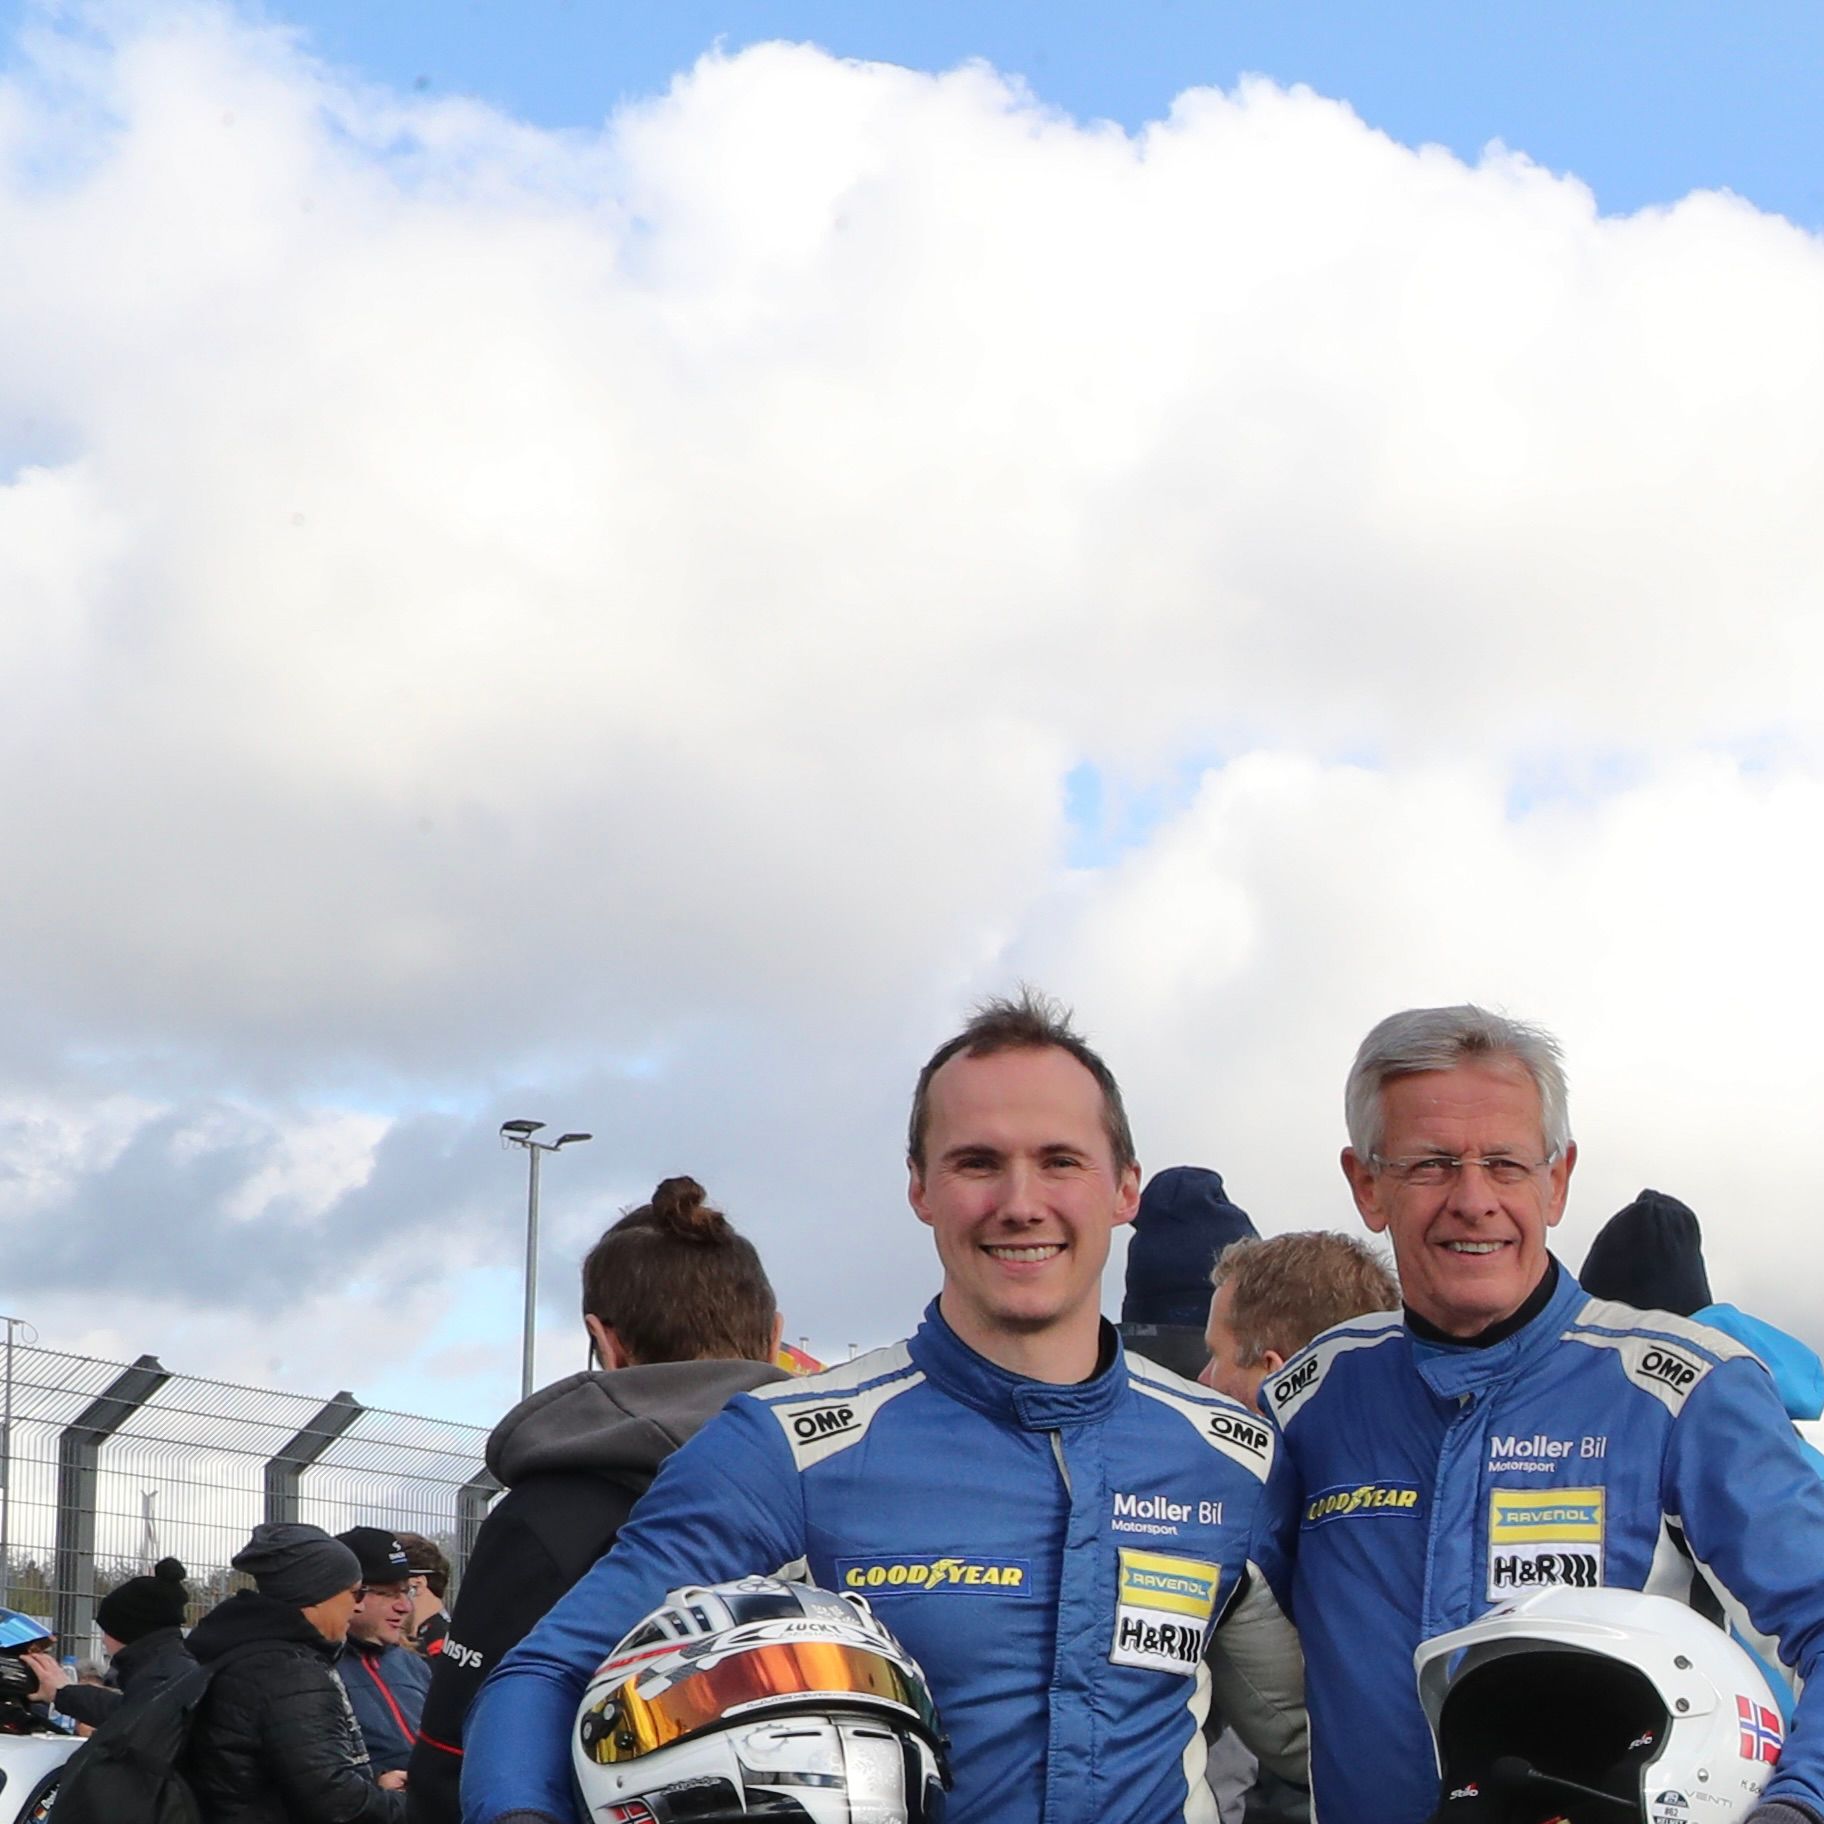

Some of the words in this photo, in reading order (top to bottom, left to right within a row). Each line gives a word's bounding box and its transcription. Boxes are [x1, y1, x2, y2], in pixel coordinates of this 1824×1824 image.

[1274, 1359, 1319, 1401] OMP
[1641, 1351, 1695, 1387] OMP
[793, 1408, 854, 1438] OMP
[1209, 1416, 1269, 1450] OMP
[1580, 1436, 1608, 1459] Bil
[1488, 1461, 1555, 1473] Motorsport
[1199, 1501, 1223, 1525] Bil
[1506, 1508, 1590, 1523] RAVENOL
[1111, 1519, 1179, 1536] Motorsport
[845, 1558, 1024, 1590] GOODYEAR
[1493, 1554, 1558, 1588] H&R
[1133, 1572, 1208, 1597] RAVENOL
[783, 1622, 843, 1634] LUCKY
[1120, 1616, 1178, 1656] H&R
[1684, 1788, 1734, 1809] VENTI
